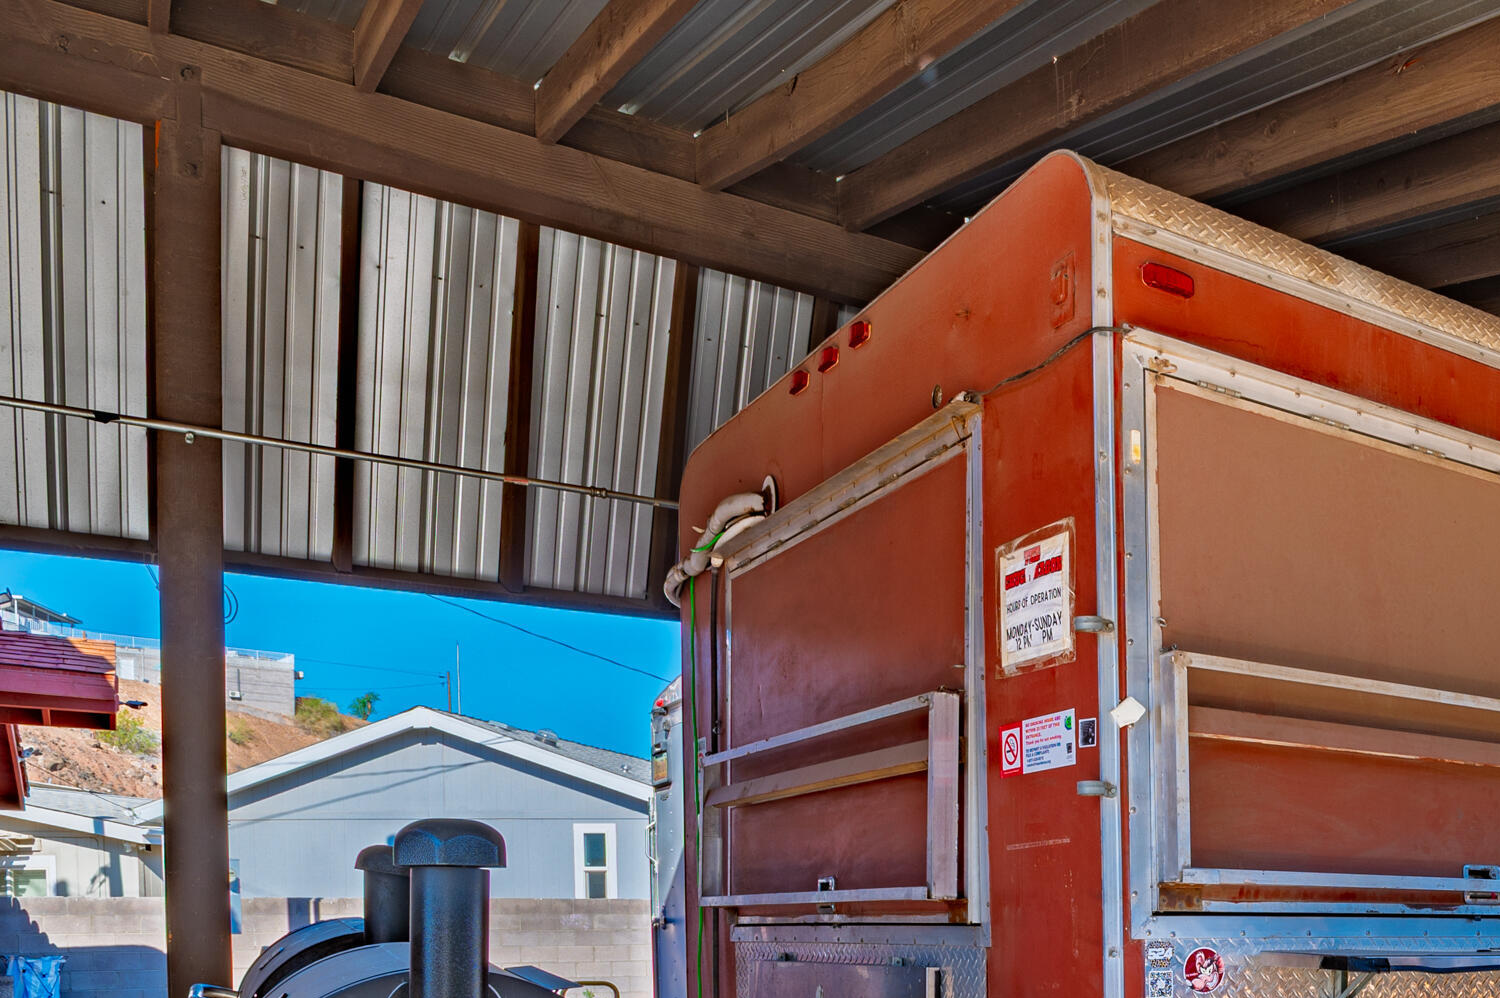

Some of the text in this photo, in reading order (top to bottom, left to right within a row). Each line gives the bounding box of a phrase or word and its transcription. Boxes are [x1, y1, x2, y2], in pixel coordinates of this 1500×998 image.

[1007, 586, 1062, 614] HOURS OF OPERATION
[1148, 947, 1173, 960] 524
